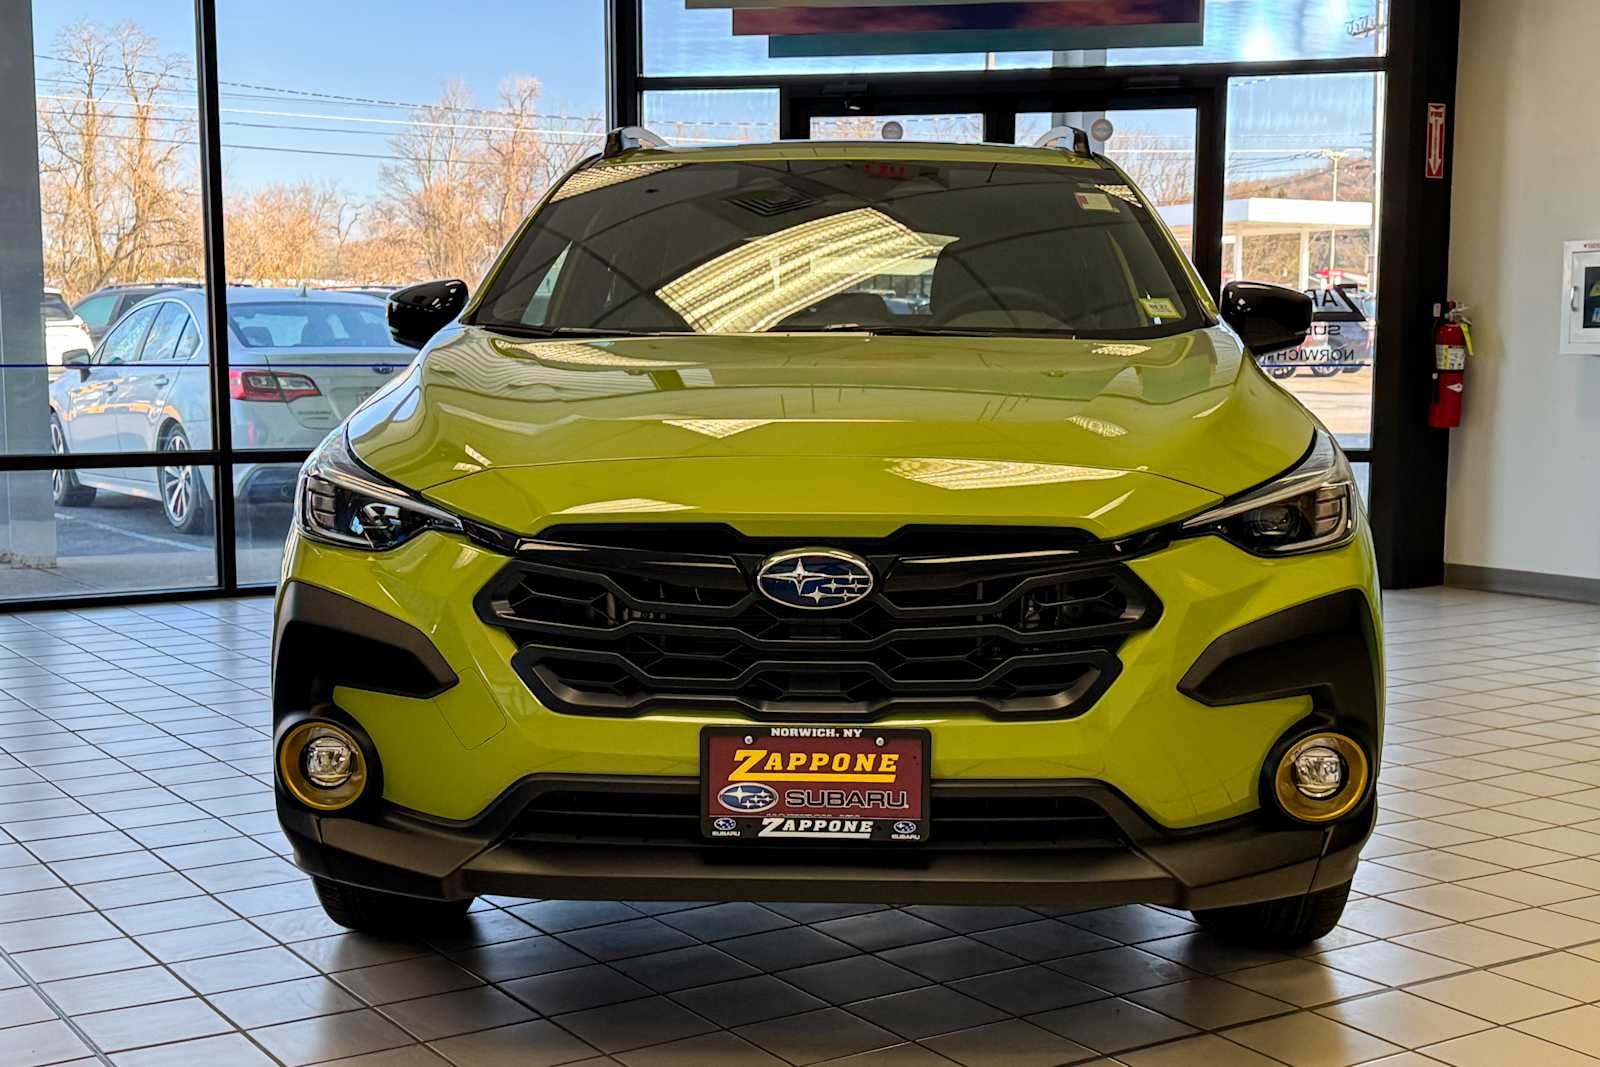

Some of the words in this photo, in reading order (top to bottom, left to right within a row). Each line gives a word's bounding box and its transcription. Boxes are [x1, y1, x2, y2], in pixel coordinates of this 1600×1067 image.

[843, 728, 863, 738] NY
[728, 749, 900, 784] ZAPPONE
[785, 789, 908, 809] SUBARU
[758, 817, 874, 840] ZAPPONE
